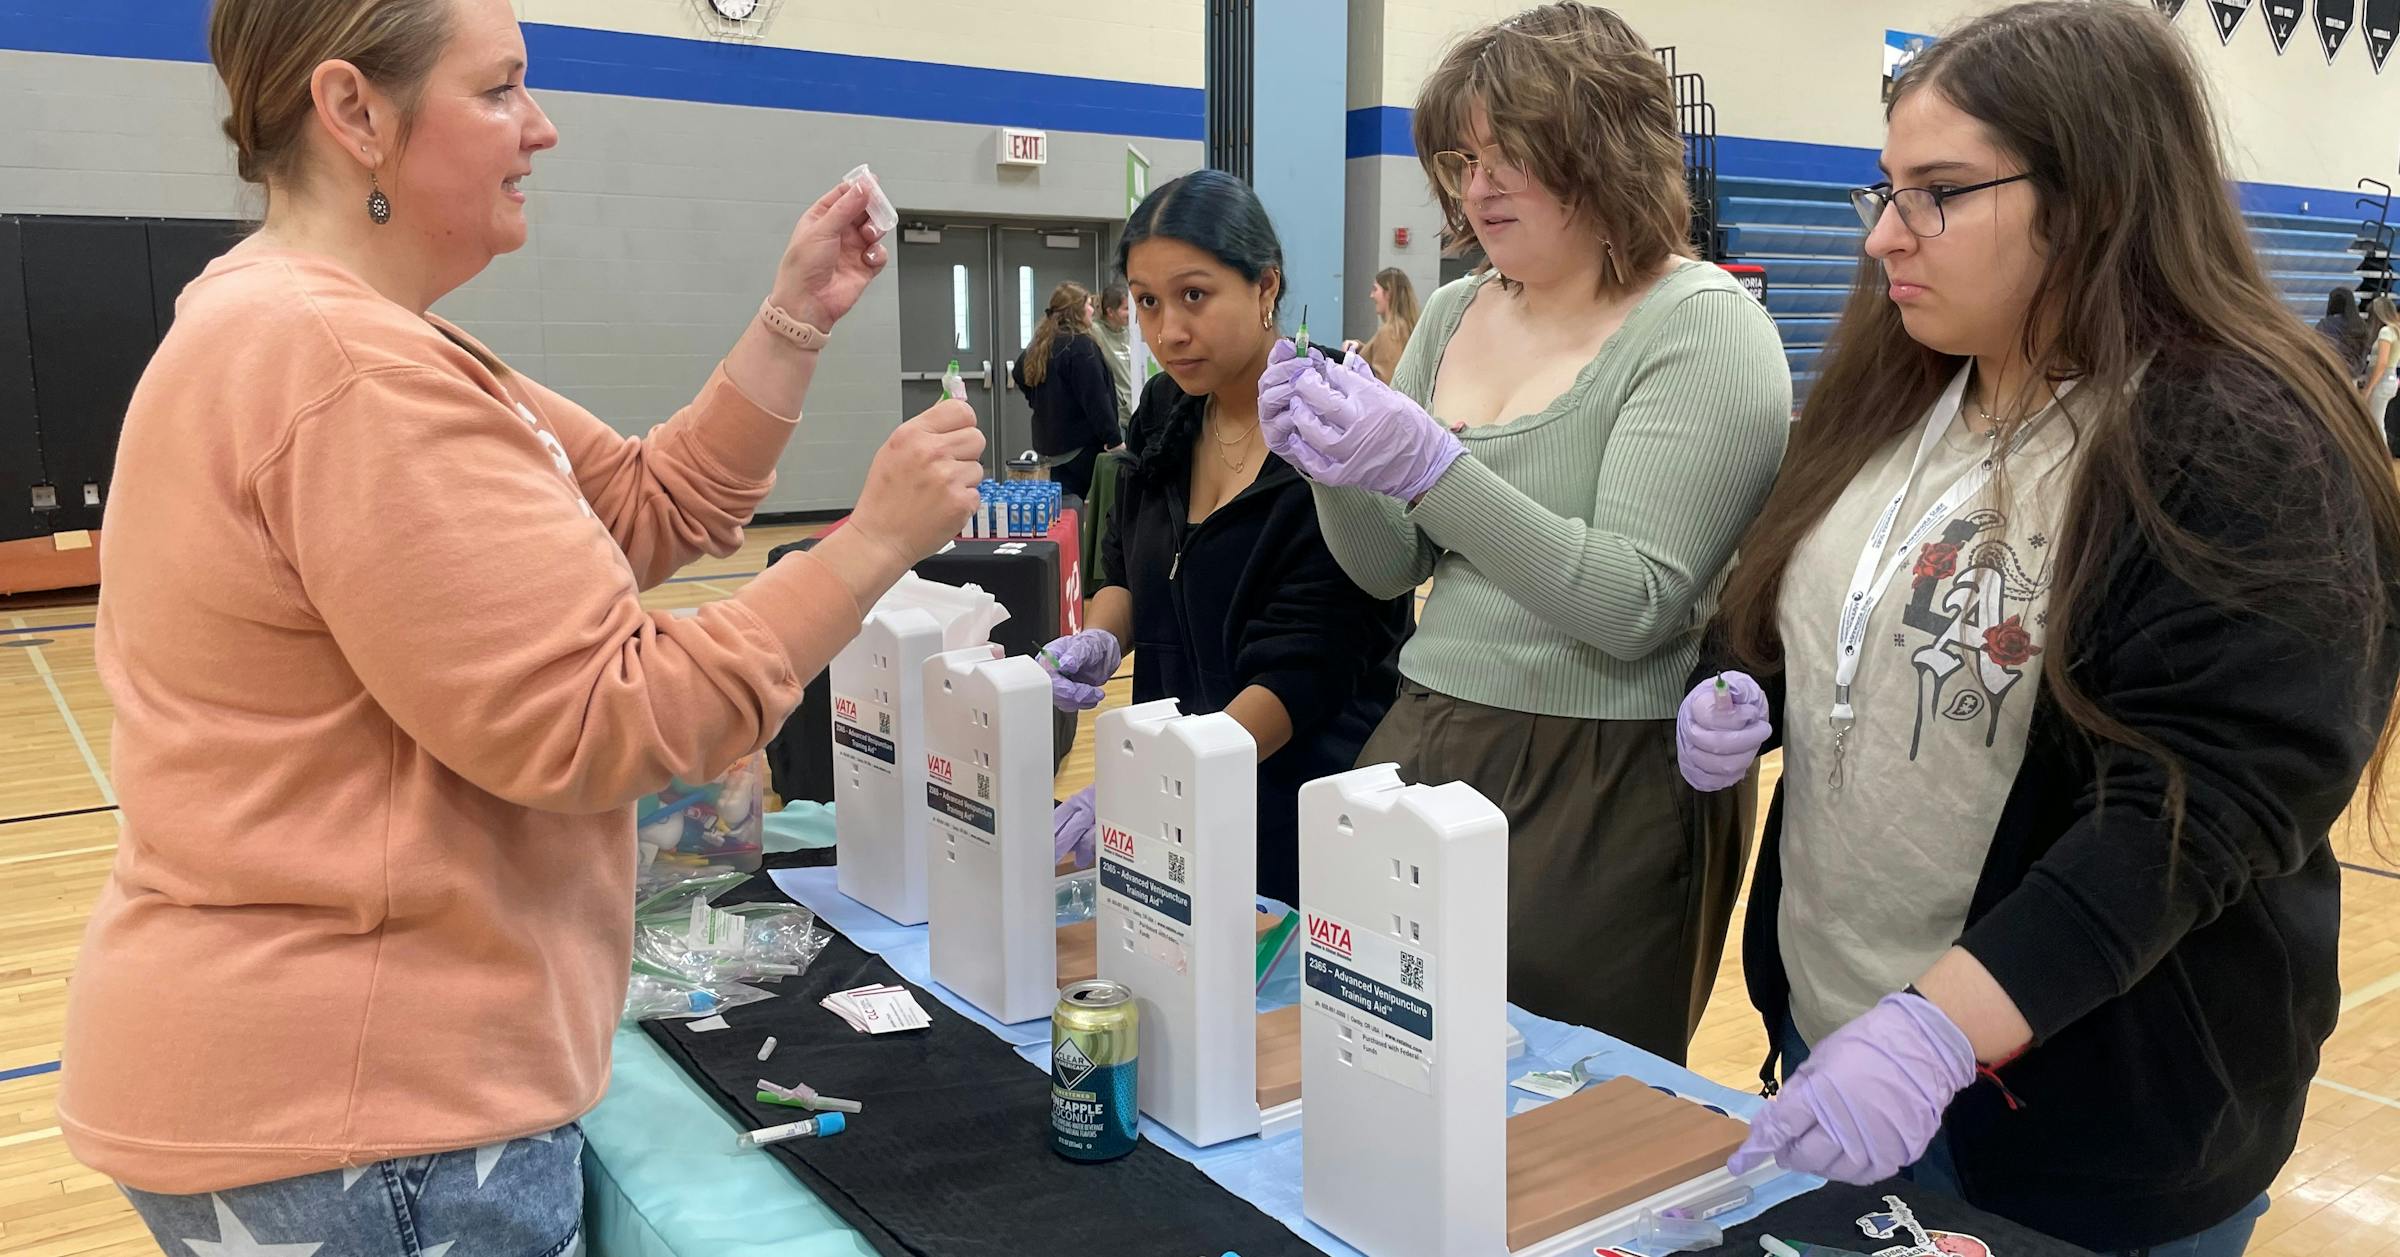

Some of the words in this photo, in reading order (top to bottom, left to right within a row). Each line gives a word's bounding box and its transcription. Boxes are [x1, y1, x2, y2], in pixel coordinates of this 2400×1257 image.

[1013, 135, 1040, 160] EXIT
[1739, 276, 1763, 289] NDRIA
[835, 697, 857, 718] VATA
[928, 753, 952, 778] VATA
[1102, 824, 1134, 855] VATA
[1121, 869, 1149, 889] Advanced
[1149, 881, 1188, 907] Venipuncture
[1126, 883, 1149, 903] Training
[1308, 913, 1352, 952] VATA
[1309, 957, 1327, 974] 2365
[1334, 968, 1373, 993] Advanced
[1373, 984, 1428, 1018] Venipuncture
[1340, 985, 1372, 1011] Training
[1058, 1052, 1085, 1065] CLEAR
[1362, 1034, 1388, 1049] Purchased
[1388, 1043, 1400, 1053] with
[1400, 1047, 1420, 1060] Federal
[1363, 1044, 1378, 1056] Funds
[1053, 1103, 1096, 1124] COCONUT
